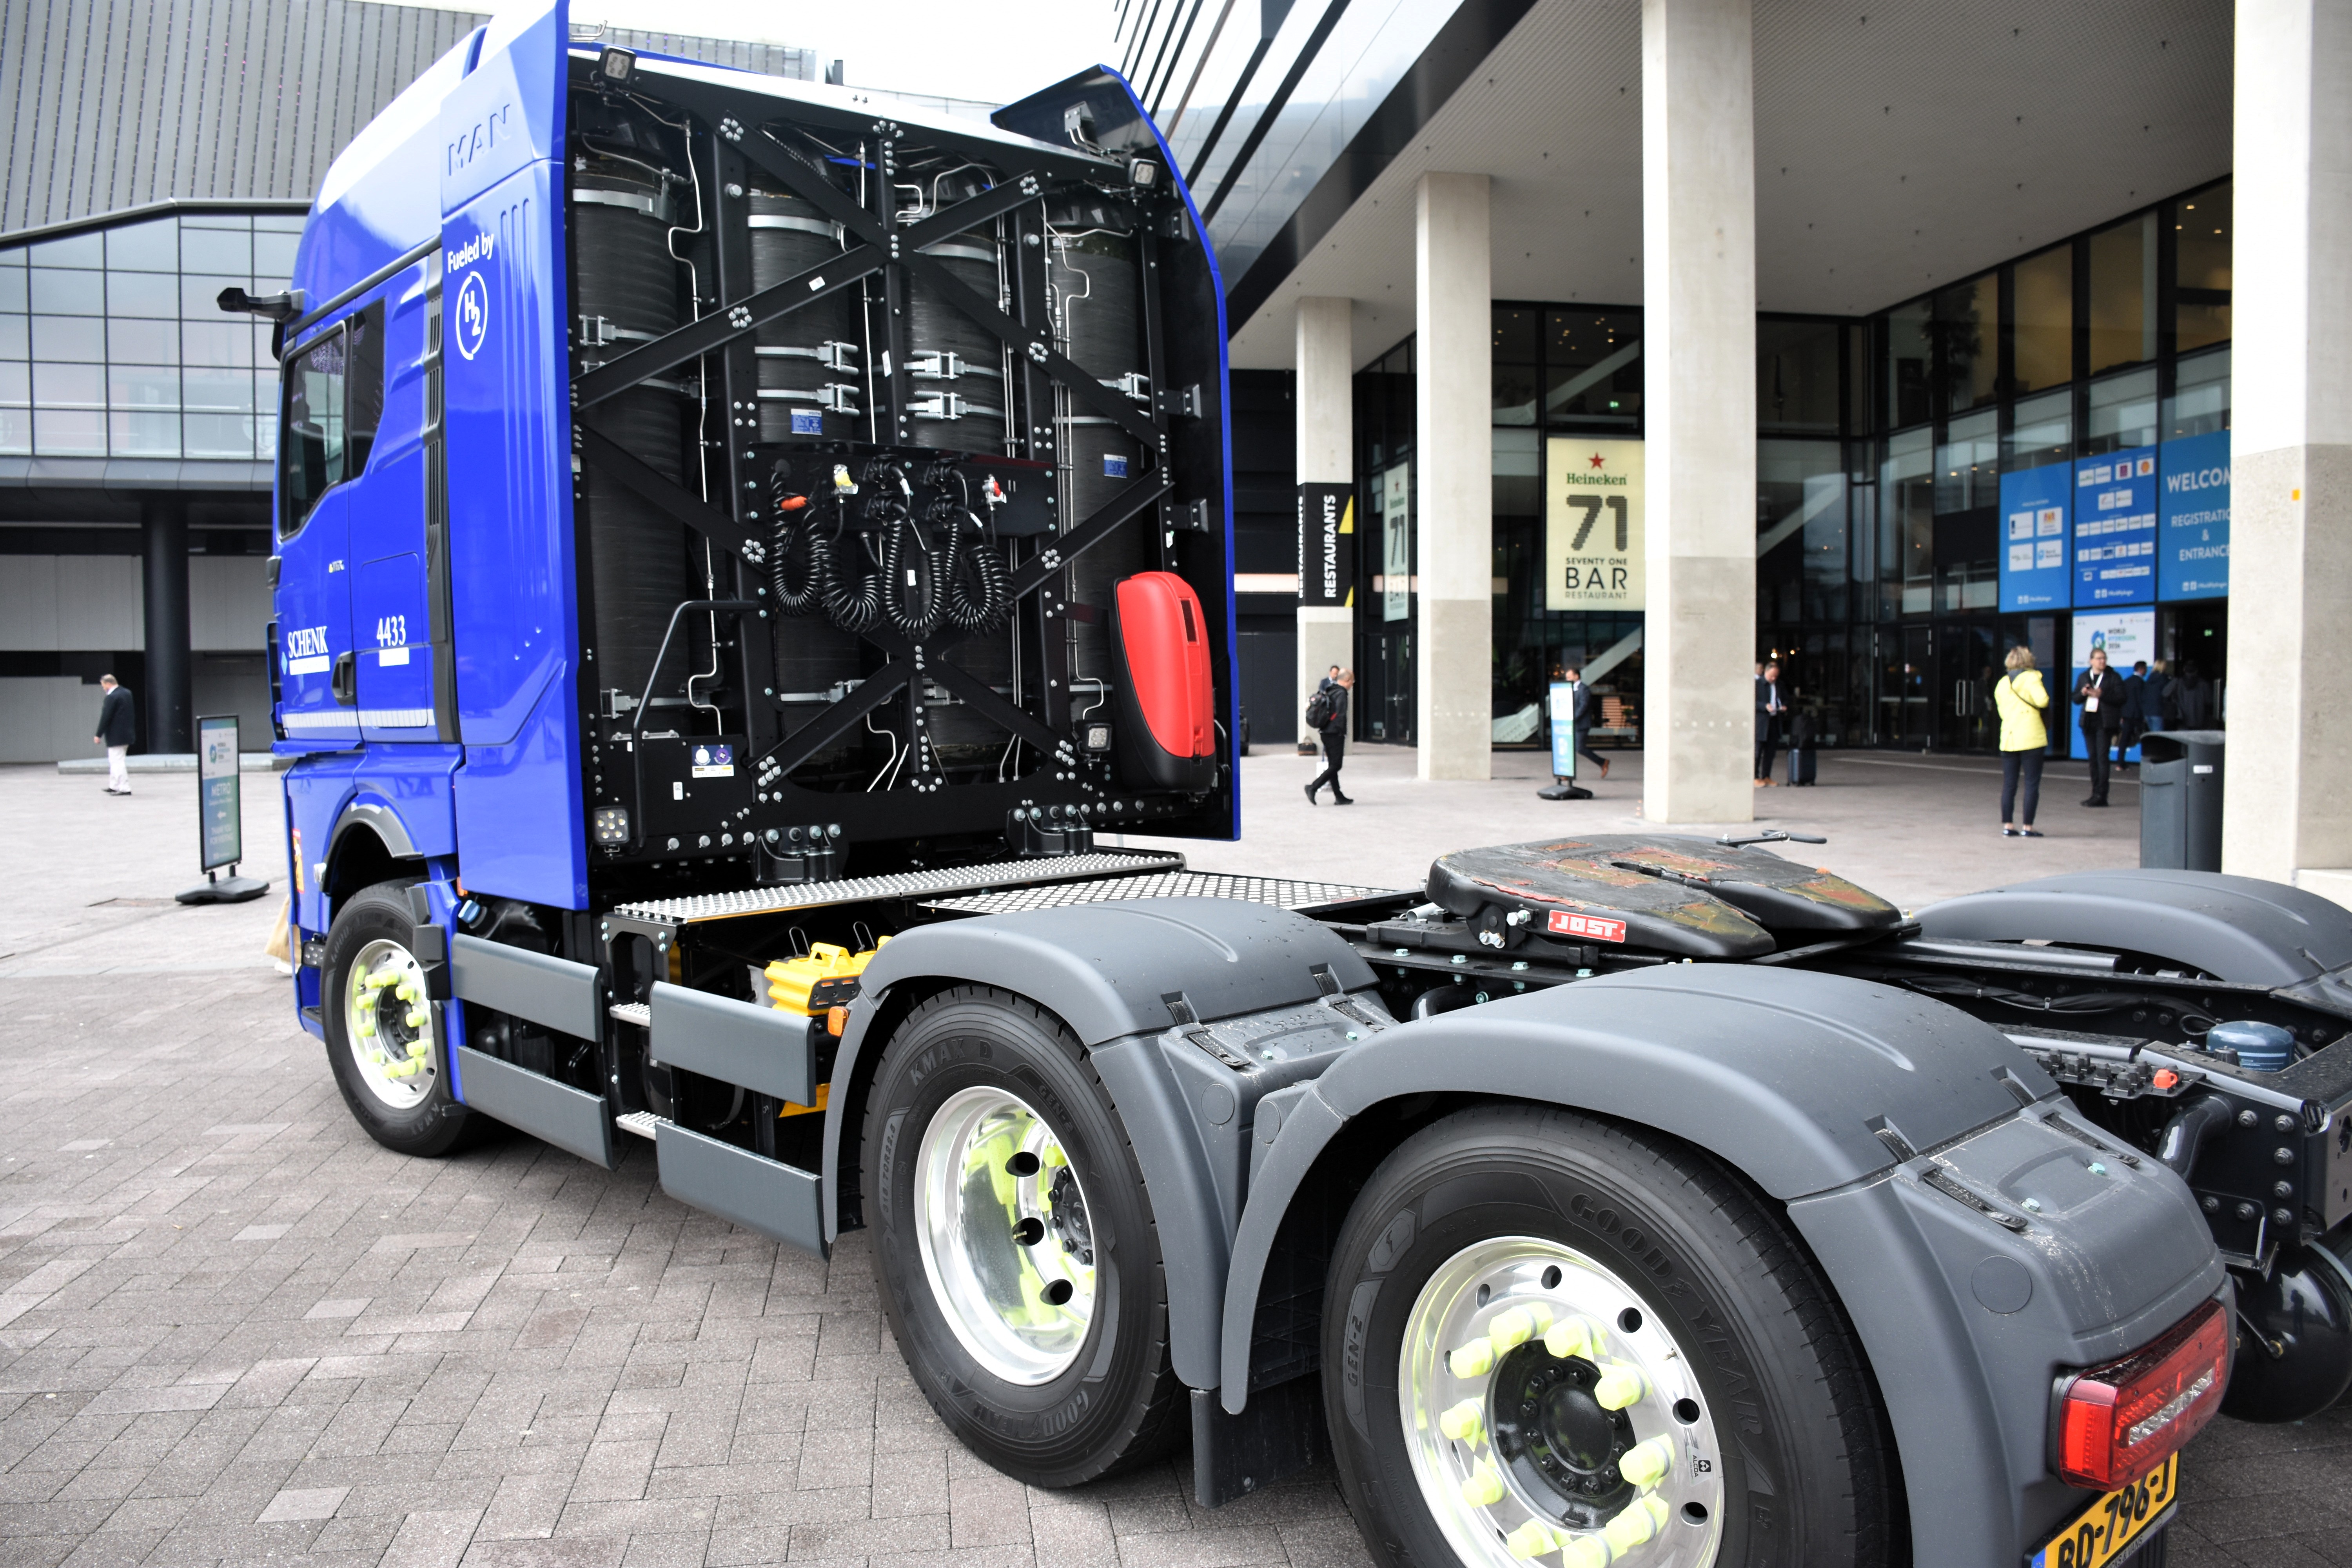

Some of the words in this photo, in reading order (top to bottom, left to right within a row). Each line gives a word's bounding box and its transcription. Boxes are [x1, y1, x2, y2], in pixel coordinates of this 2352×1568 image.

[447, 103, 511, 177] MAN
[448, 237, 480, 273] Fueled
[481, 233, 494, 257] by
[1567, 473, 1628, 485] Heineken
[1390, 514, 1405, 568] 71
[1566, 495, 1628, 552] 71
[2202, 529, 2209, 541] &
[1323, 494, 1336, 598] RESTAURANTS
[1565, 591, 1628, 600] RESTAURANT
[1566, 567, 1628, 590] BAR
[288, 626, 328, 659] SCHENK
[377, 615, 406, 647] 4433
[1555, 915, 1618, 937] JOST
[910, 1038, 965, 1087] KMAX
[979, 1040, 993, 1061] D
[1039, 1085, 1074, 1134] GEN-2
[1348, 1314, 1363, 1387] GEN-2
